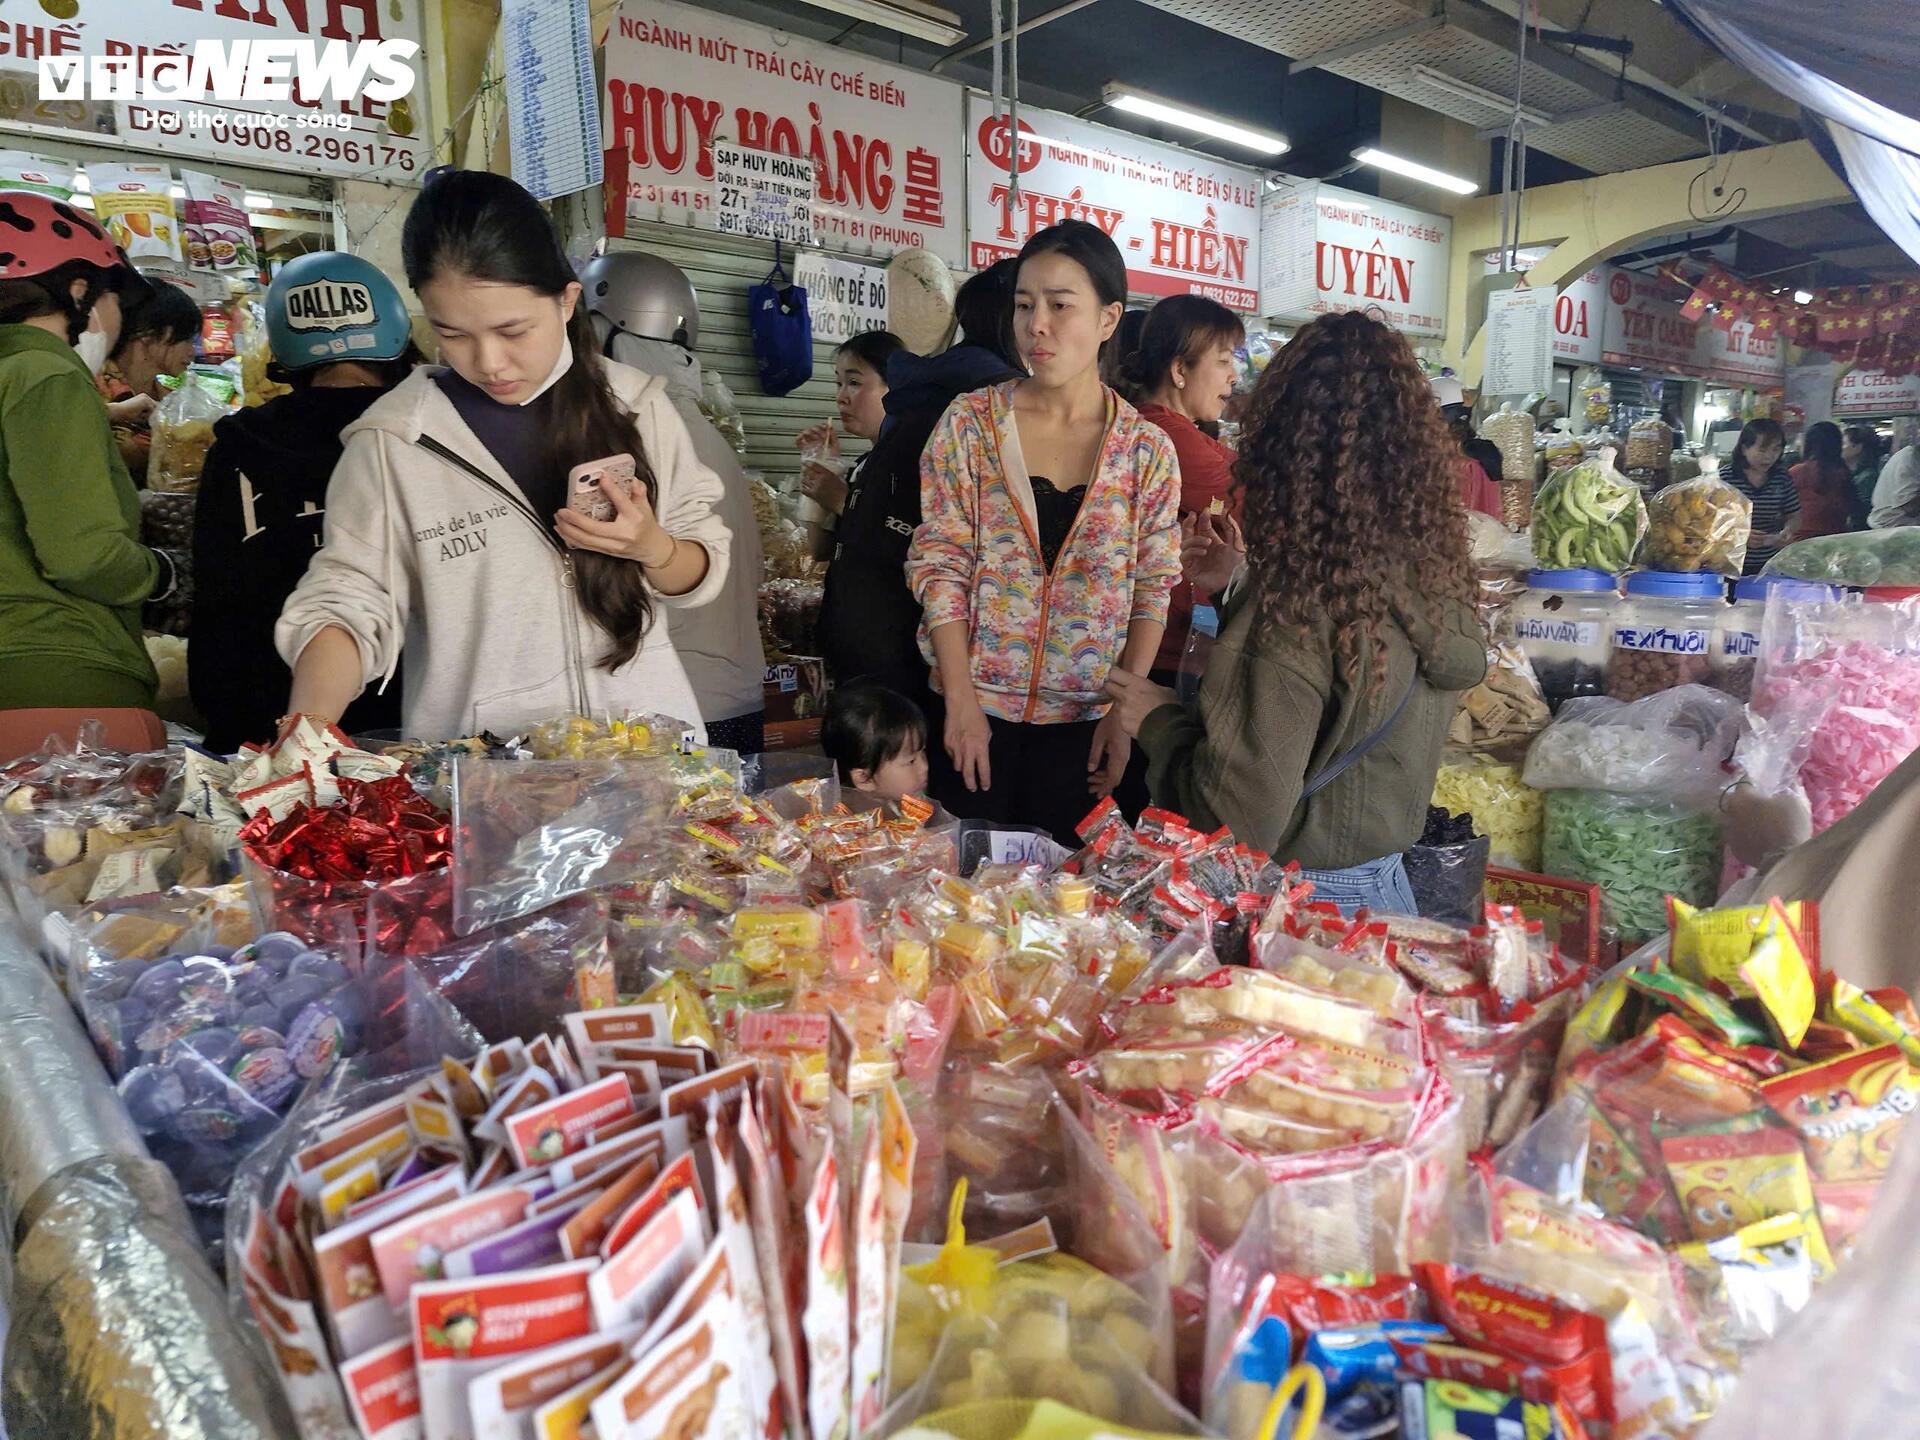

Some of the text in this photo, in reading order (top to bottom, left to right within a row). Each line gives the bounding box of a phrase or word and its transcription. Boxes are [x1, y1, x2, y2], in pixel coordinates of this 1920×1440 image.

[619, 16, 905, 108] NGÀNH MỨT TRÁI CÂY CHẾ BIẾN
[210, 118, 416, 171] 0908.296176
[608, 78, 724, 181] HUY
[735, 101, 896, 214] HOÀNG
[717, 150, 812, 182] SẠP HUY HOÀNG
[736, 175, 748, 187] RA
[903, 145, 945, 228] 皇
[1173, 167, 1196, 193] CHẾ
[1196, 173, 1220, 200] BIẾN
[647, 184, 665, 204] 31
[671, 188, 688, 208] 41
[694, 192, 711, 212] 51
[832, 217, 846, 235] 71
[851, 221, 865, 238] 81
[869, 225, 924, 248] (PHỤNG)
[720, 187, 740, 208] 27
[1150, 203, 1249, 283] HIỀN
[798, 266, 845, 304] KHÔNG
[849, 267, 865, 307] ĐỂ
[1315, 237, 1416, 304] UYÊN
[288, 285, 368, 319] DALLAS
[448, 516, 467, 533] de
[467, 510, 484, 527] la
[484, 502, 509, 520] vie
[440, 527, 488, 562] ADLV
